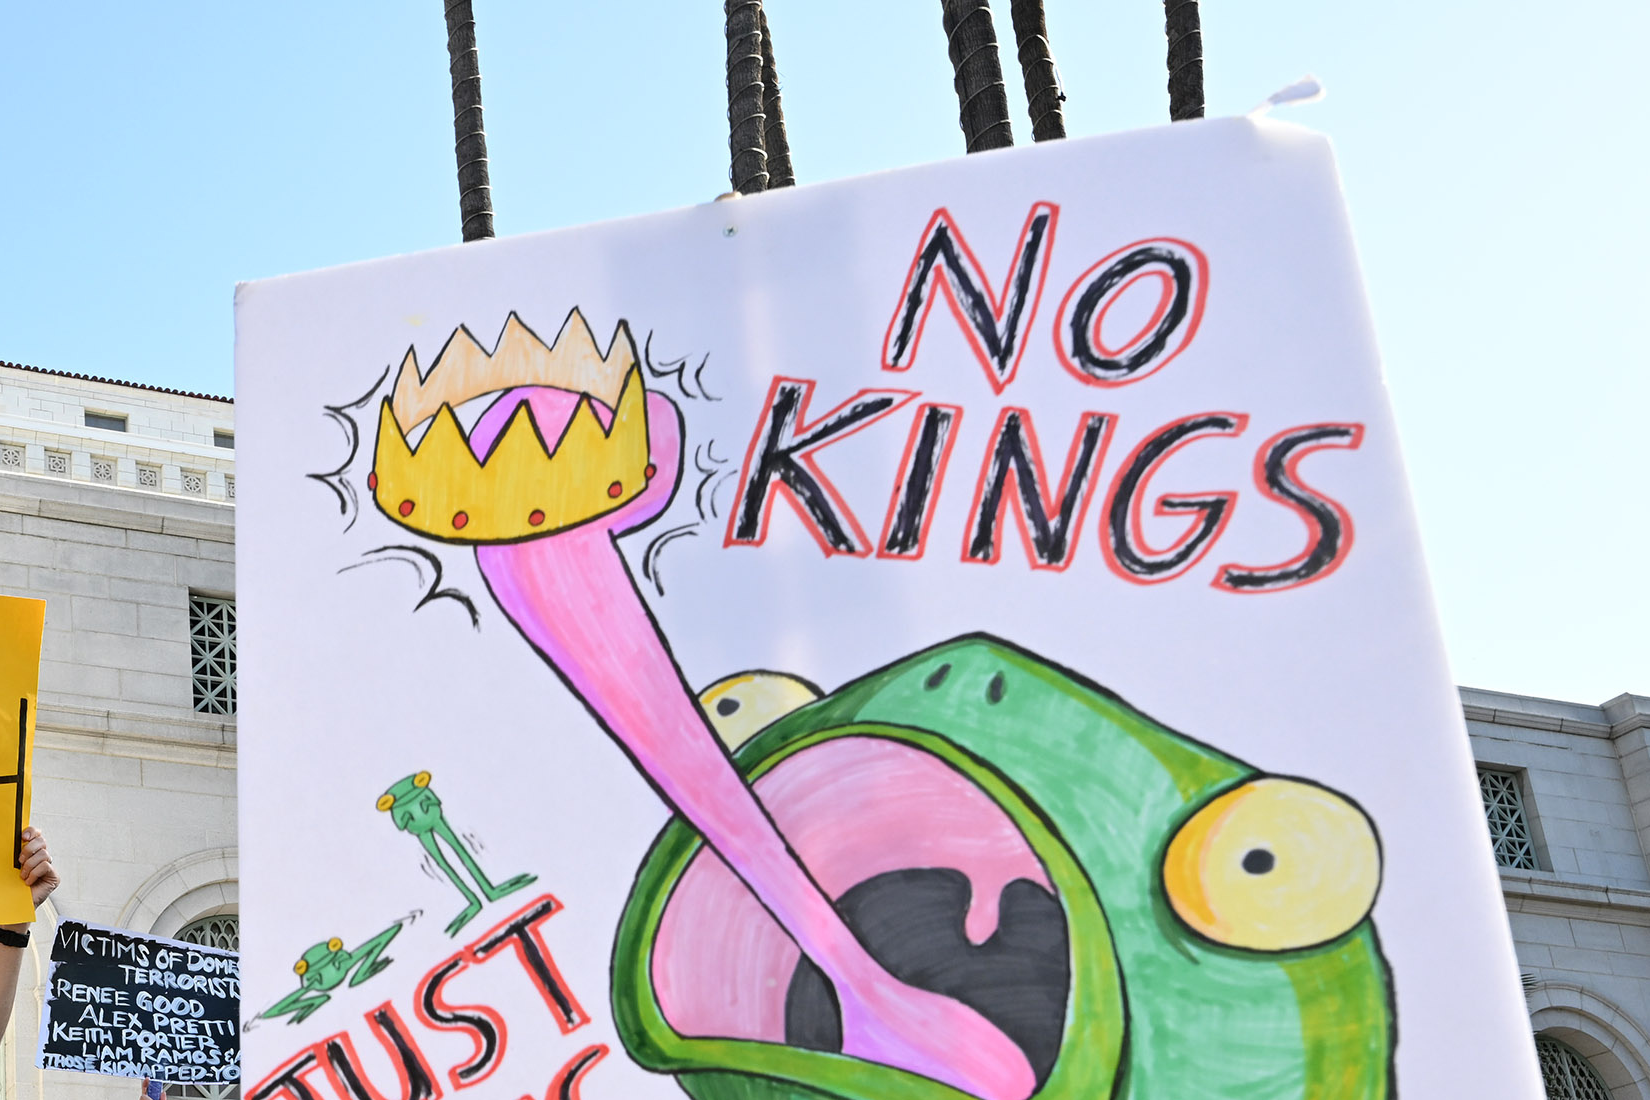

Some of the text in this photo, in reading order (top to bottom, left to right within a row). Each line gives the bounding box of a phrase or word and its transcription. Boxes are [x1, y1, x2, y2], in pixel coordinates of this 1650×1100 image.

[881, 200, 1209, 395] NO
[723, 376, 1365, 595] KINGS
[59, 928, 150, 967] VICTIMS
[155, 949, 184, 971] OF
[57, 979, 205, 1018] RENEE GOOD
[52, 1021, 220, 1051] KEITH PORTER
[78, 1005, 235, 1036] ALEX PRETTI
[44, 1053, 97, 1070] THOSE
[82, 1043, 133, 1062] LIAM
[141, 1048, 222, 1066] RAMOS
